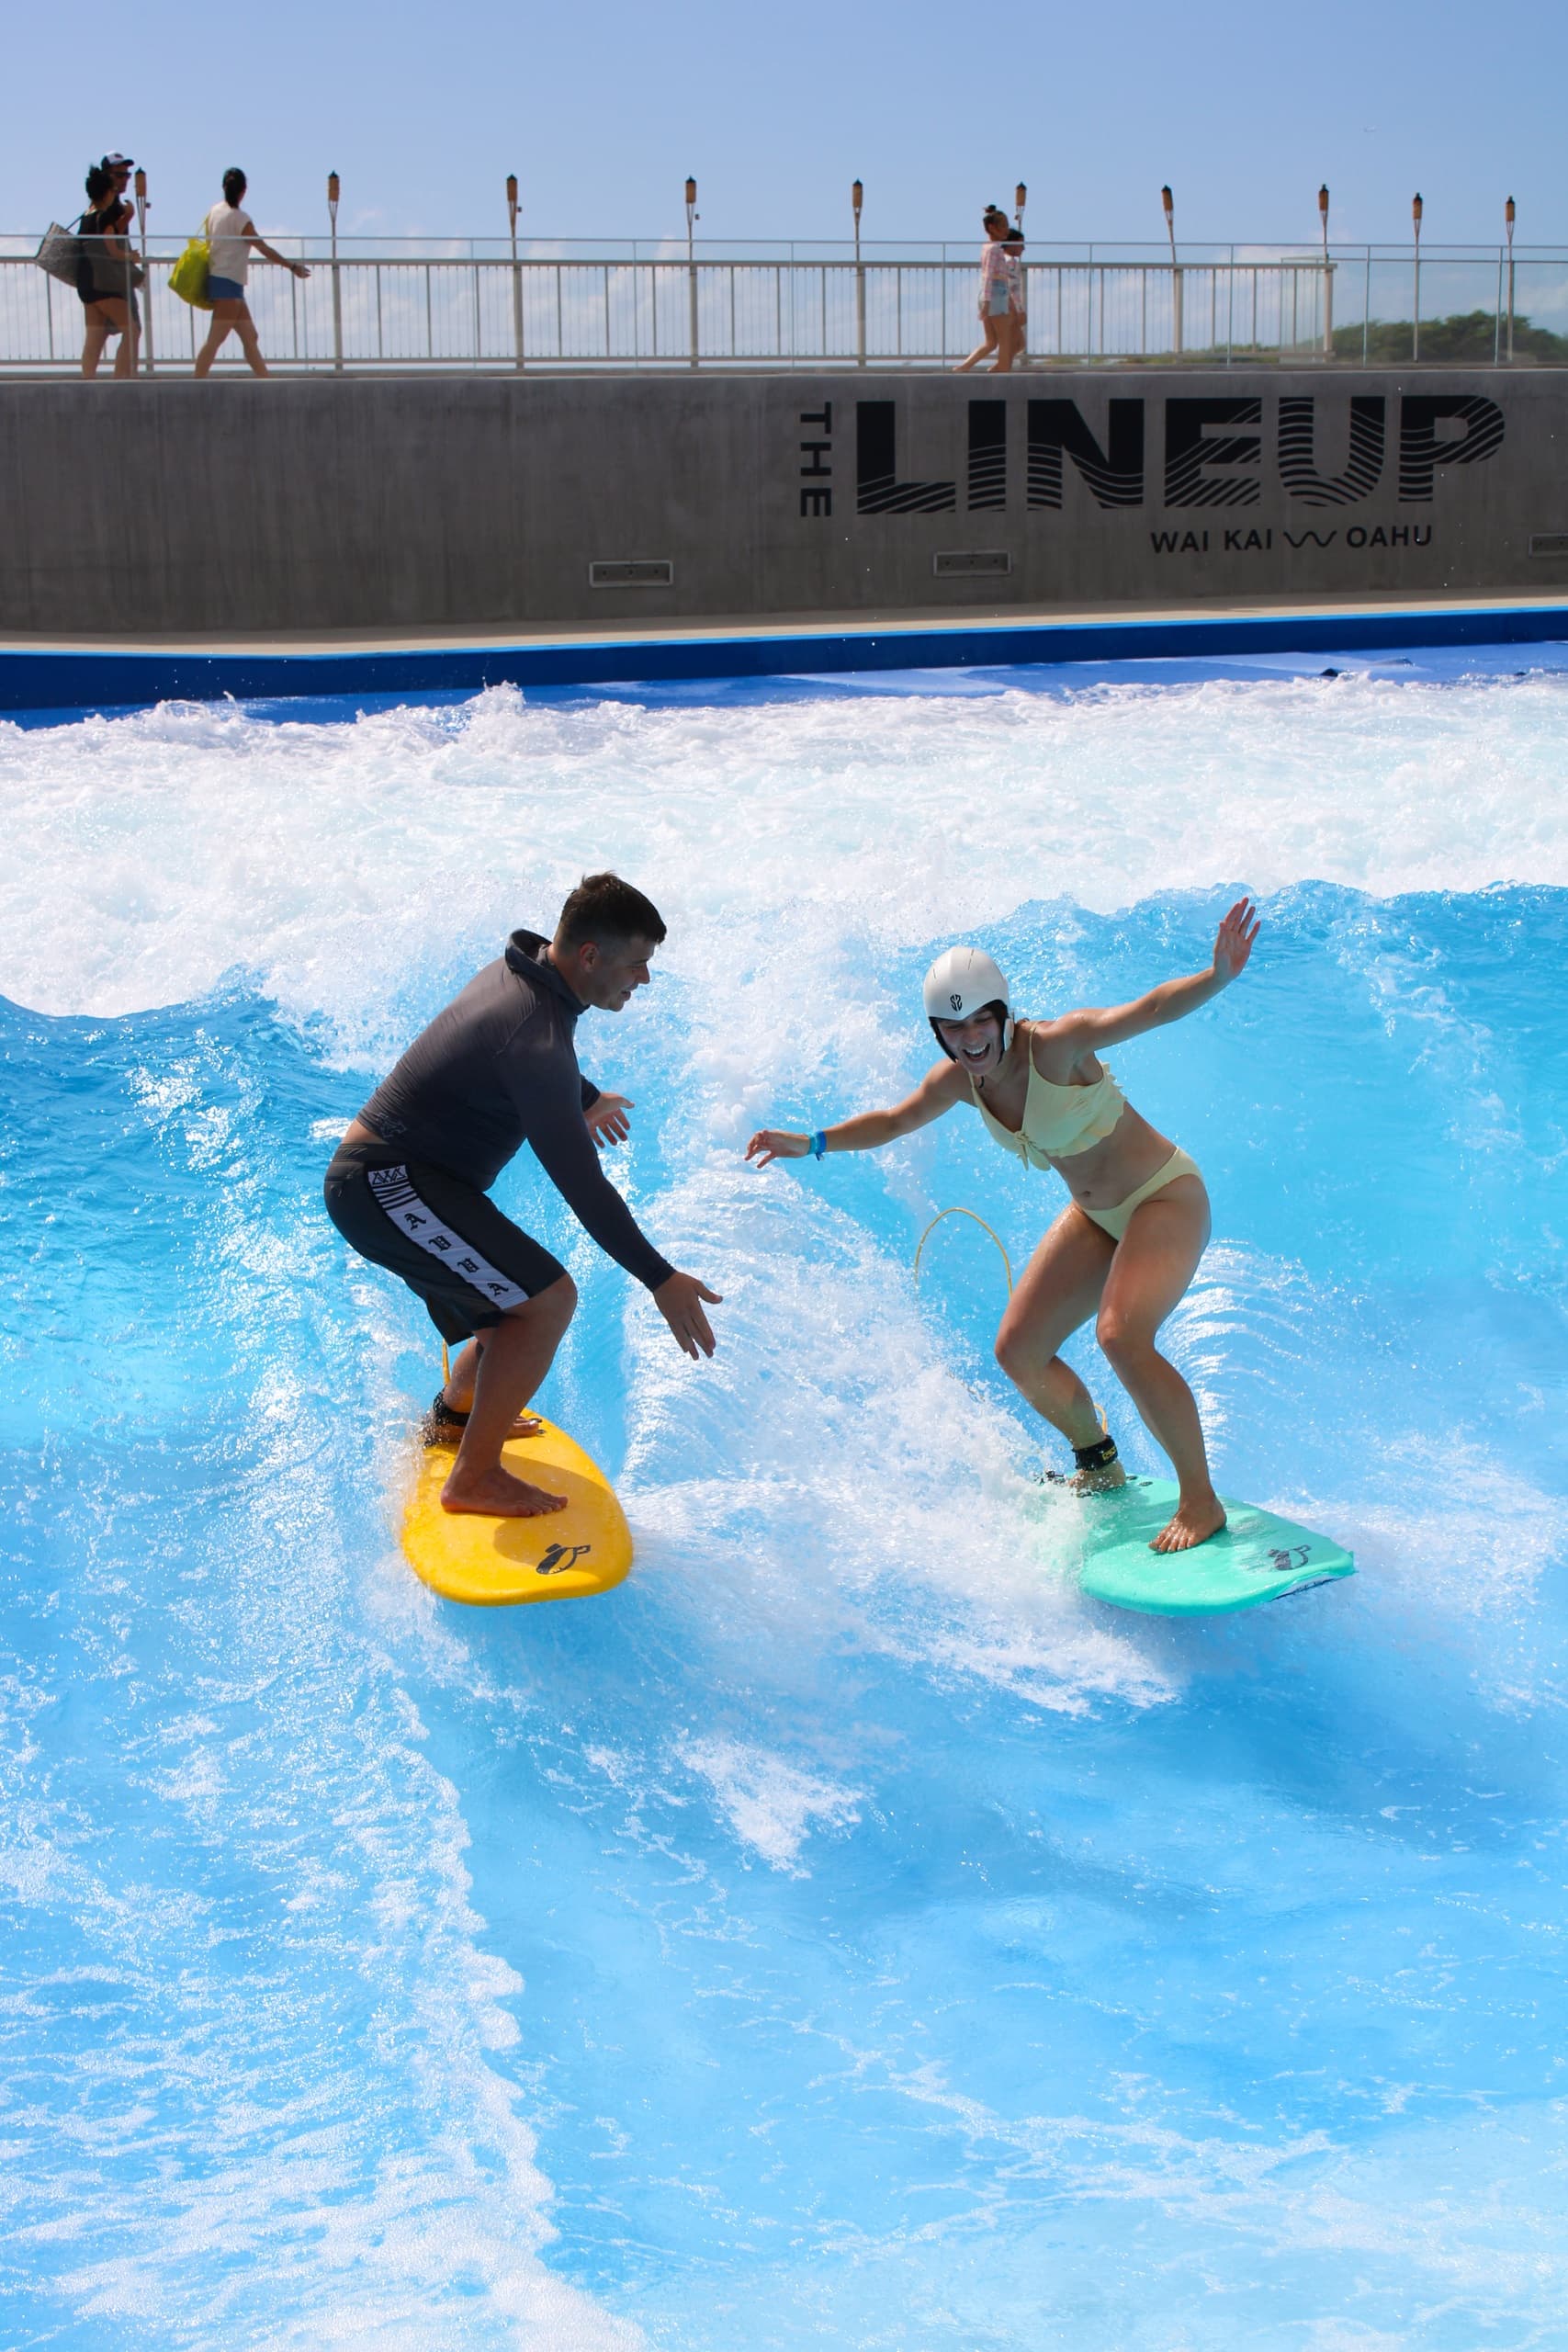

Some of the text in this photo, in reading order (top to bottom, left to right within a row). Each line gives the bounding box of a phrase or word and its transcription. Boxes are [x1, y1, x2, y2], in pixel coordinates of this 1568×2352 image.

[800, 395, 1505, 516] THE LINEUP
[1151, 525, 1432, 552] WAI KAI OAHU
